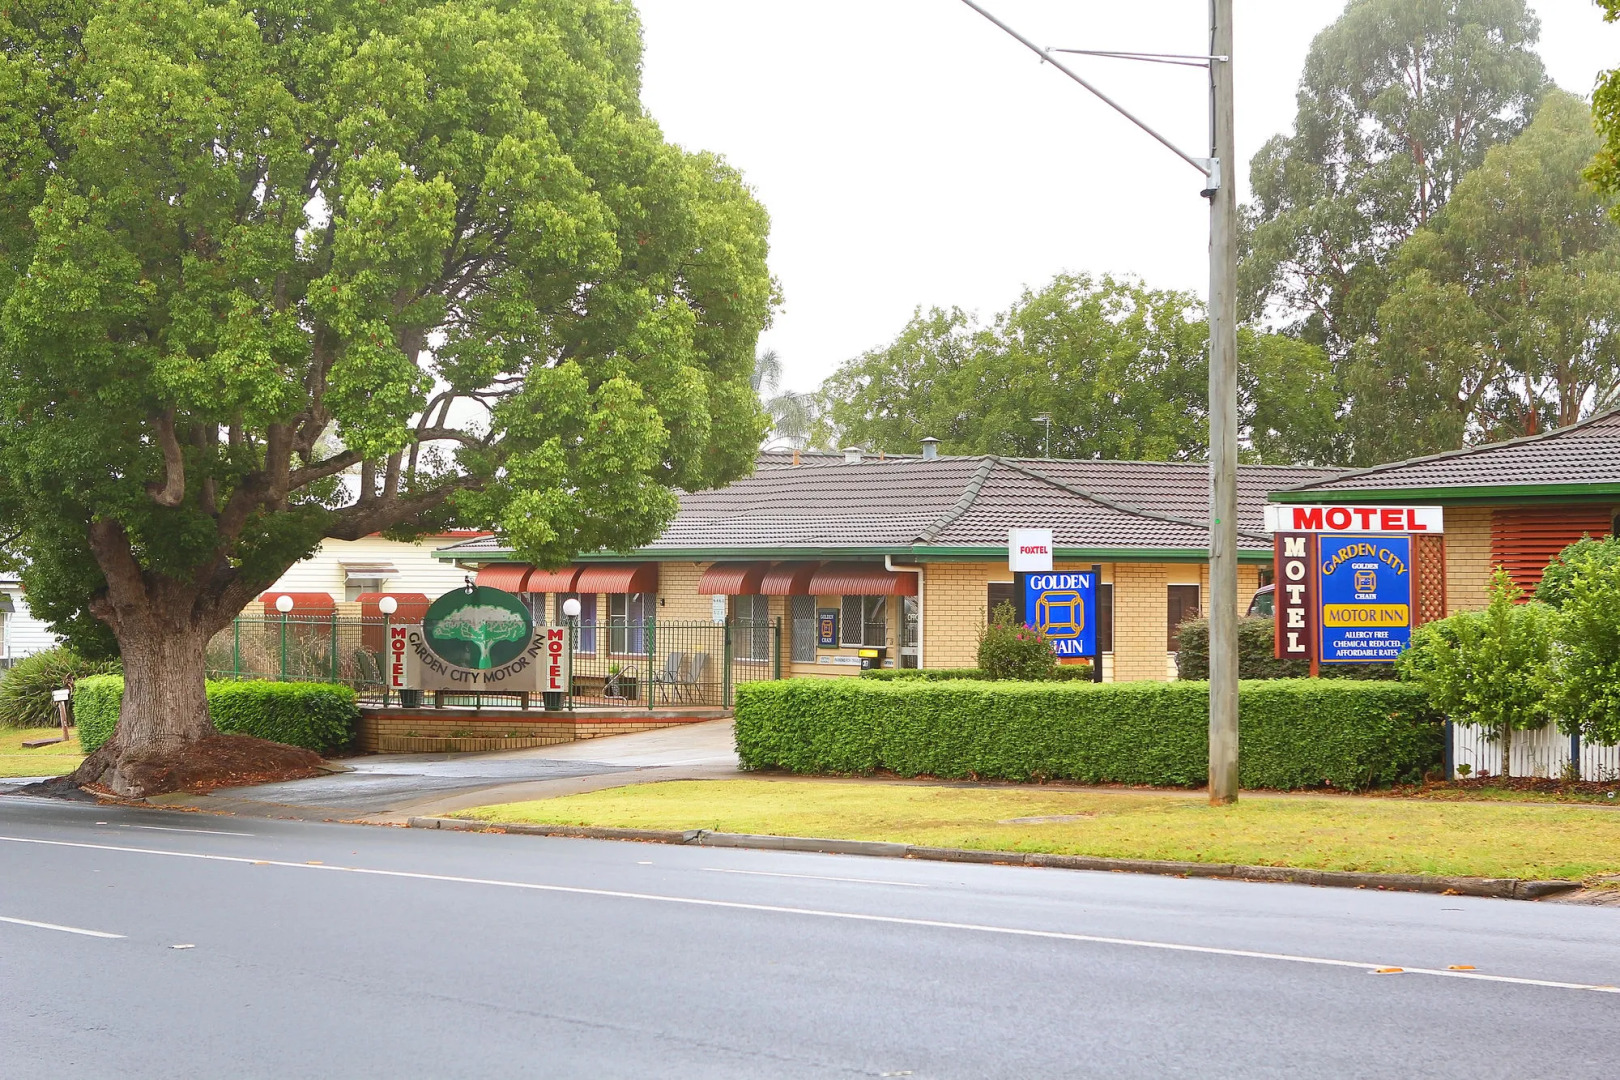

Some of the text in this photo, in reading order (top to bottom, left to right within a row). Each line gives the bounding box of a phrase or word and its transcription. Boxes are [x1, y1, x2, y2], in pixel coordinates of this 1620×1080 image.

[1293, 507, 1427, 530] MOTEL
[1020, 546, 1048, 554] FOXTEL
[1322, 543, 1408, 576] GARDEN CITY
[1030, 574, 1090, 590] GOLDEN
[1284, 537, 1306, 653] MOTEL
[1328, 609, 1404, 622] MOTOR INN
[1333, 640, 1368, 648] CHEMICAL
[1344, 631, 1389, 639] ALLERGY FREE
[391, 627, 407, 687] MOTEL
[409, 632, 546, 684] GARDEN CITY MOTOR INN
[547, 629, 564, 689] MOTEL
[1336, 649, 1399, 657] AFFORDABLE RATES
